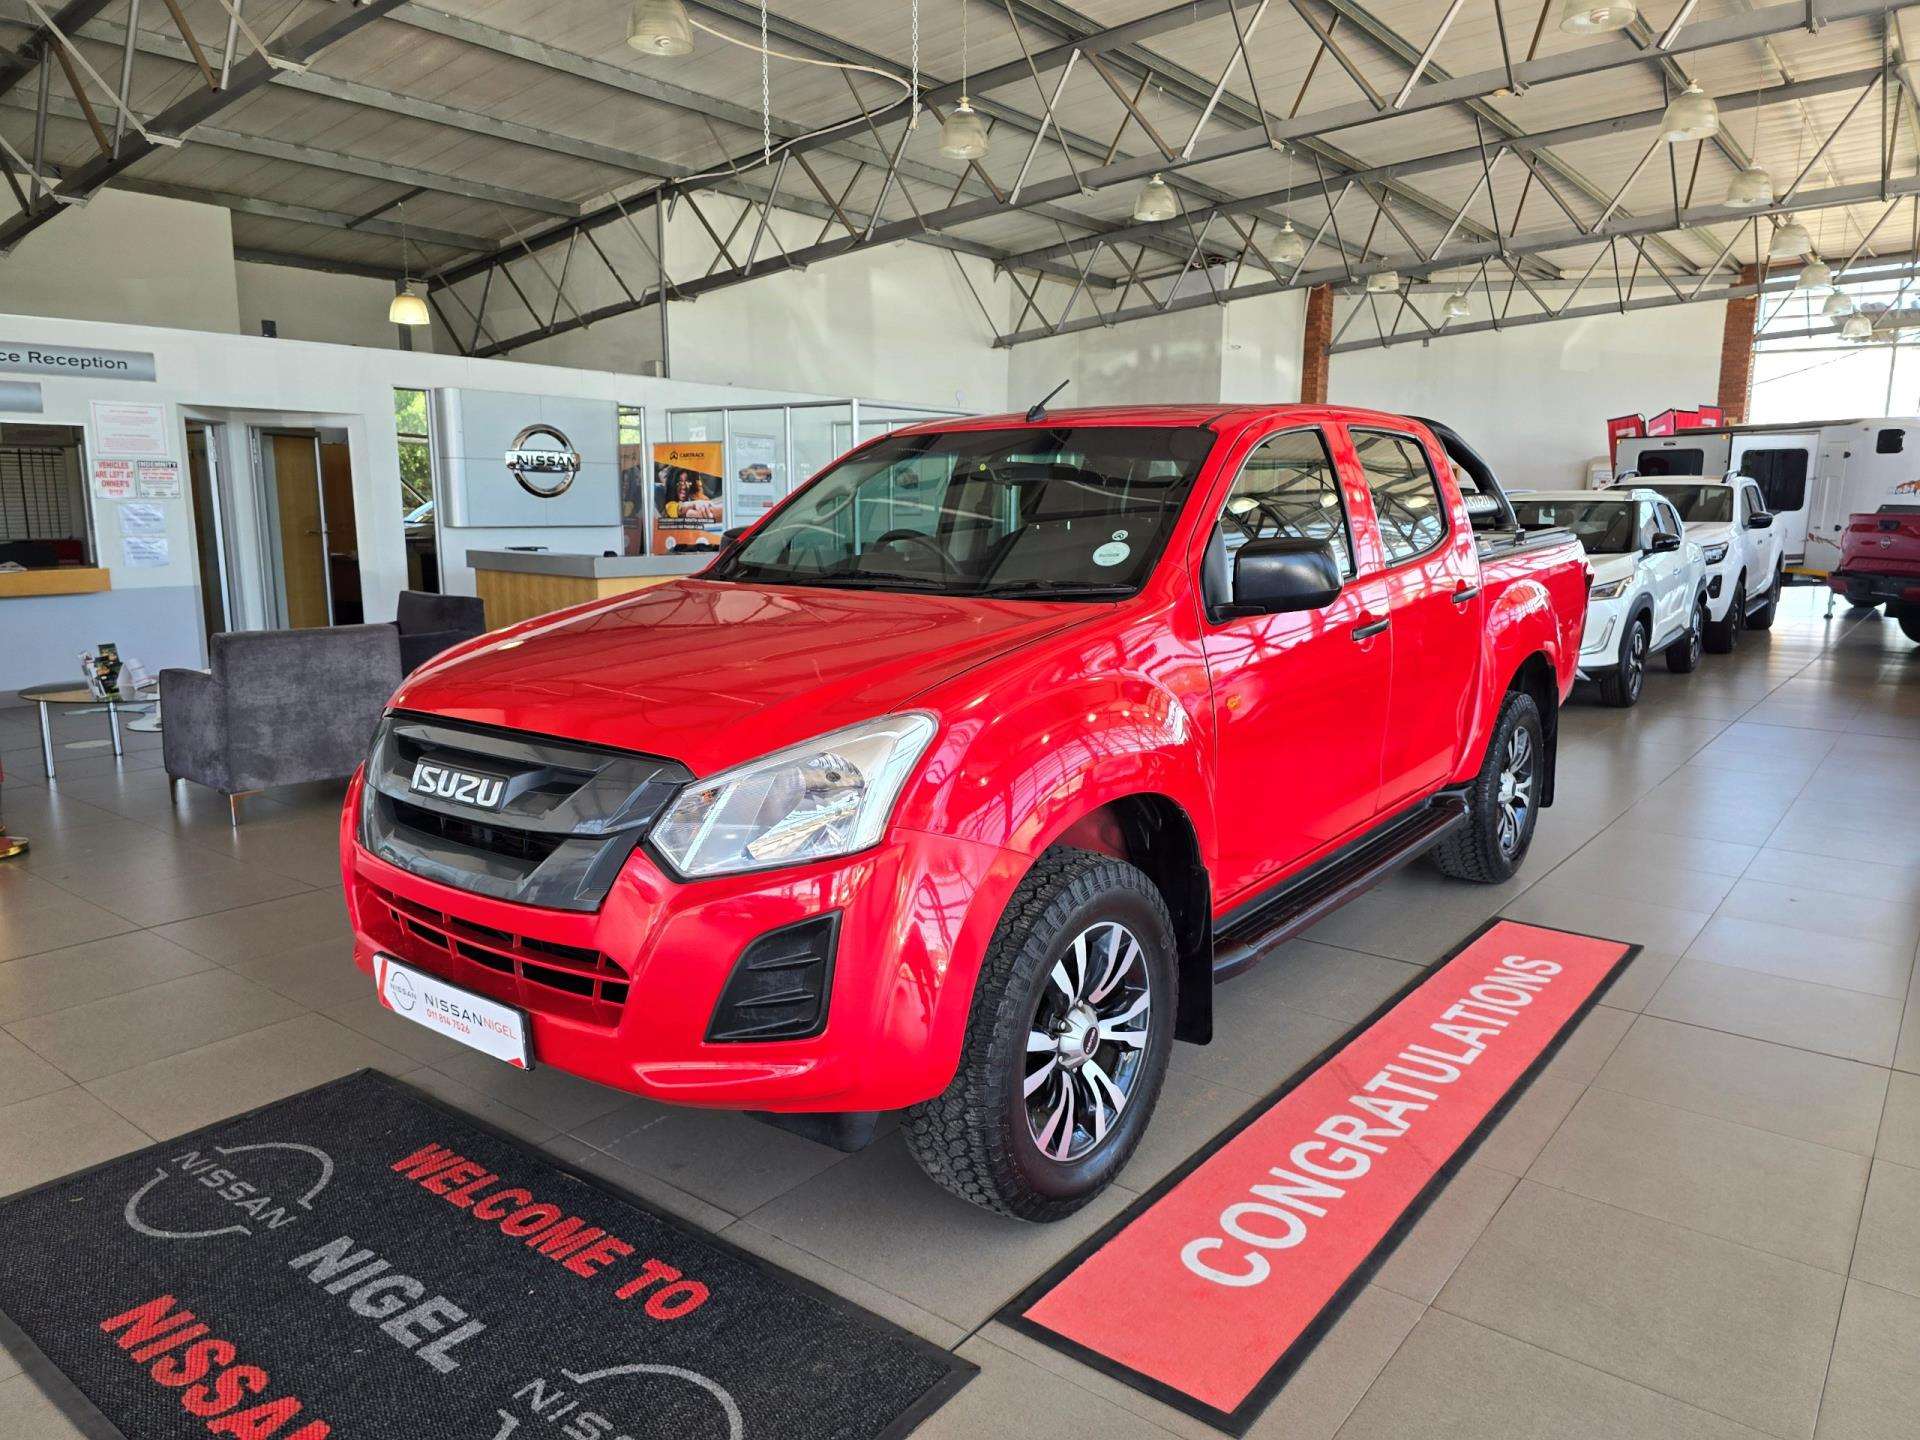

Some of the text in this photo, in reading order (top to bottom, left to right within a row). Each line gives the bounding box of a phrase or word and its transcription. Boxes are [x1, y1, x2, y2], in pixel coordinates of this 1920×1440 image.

[28, 351, 128, 370] Reception
[516, 454, 576, 469] NISSAN
[411, 764, 503, 807] ISUZU
[390, 982, 417, 1000] NISSAN
[1180, 954, 1563, 1287] CONGRATULATIONS
[171, 1151, 298, 1229] NISSAN
[391, 1142, 710, 1321] WELCOME TO
[288, 1235, 487, 1374] NIGEL
